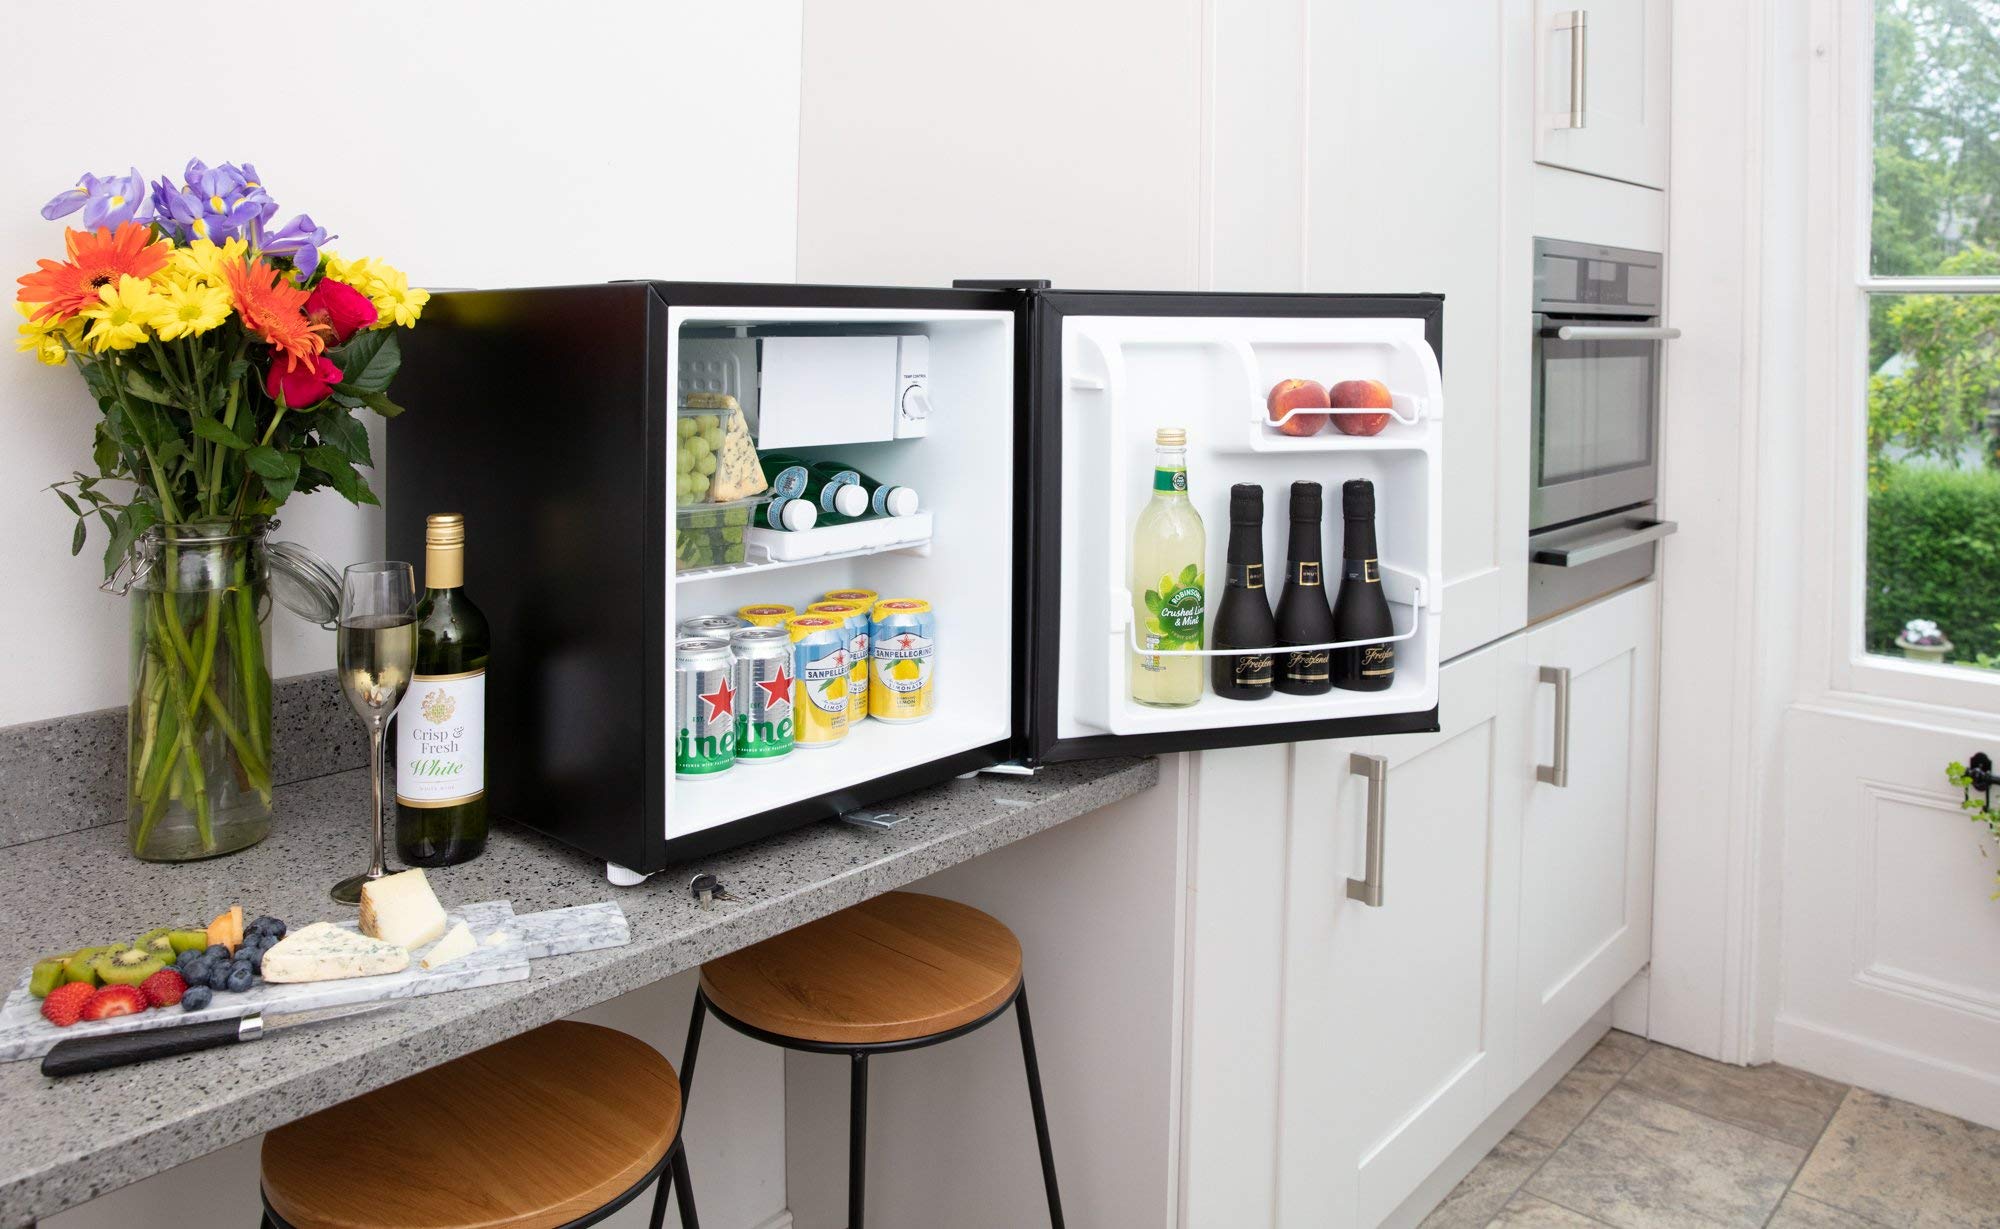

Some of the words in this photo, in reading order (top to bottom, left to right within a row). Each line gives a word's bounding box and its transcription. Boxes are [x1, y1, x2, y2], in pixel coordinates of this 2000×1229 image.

[1161, 606, 1194, 617] Crushed
[1194, 605, 1205, 615] Lim
[1174, 618, 1181, 627] &
[1182, 615, 1200, 626] Mint
[413, 728, 448, 742] Crisp
[452, 726, 464, 739] &
[421, 741, 459, 754] Fresh
[410, 759, 464, 776] White
